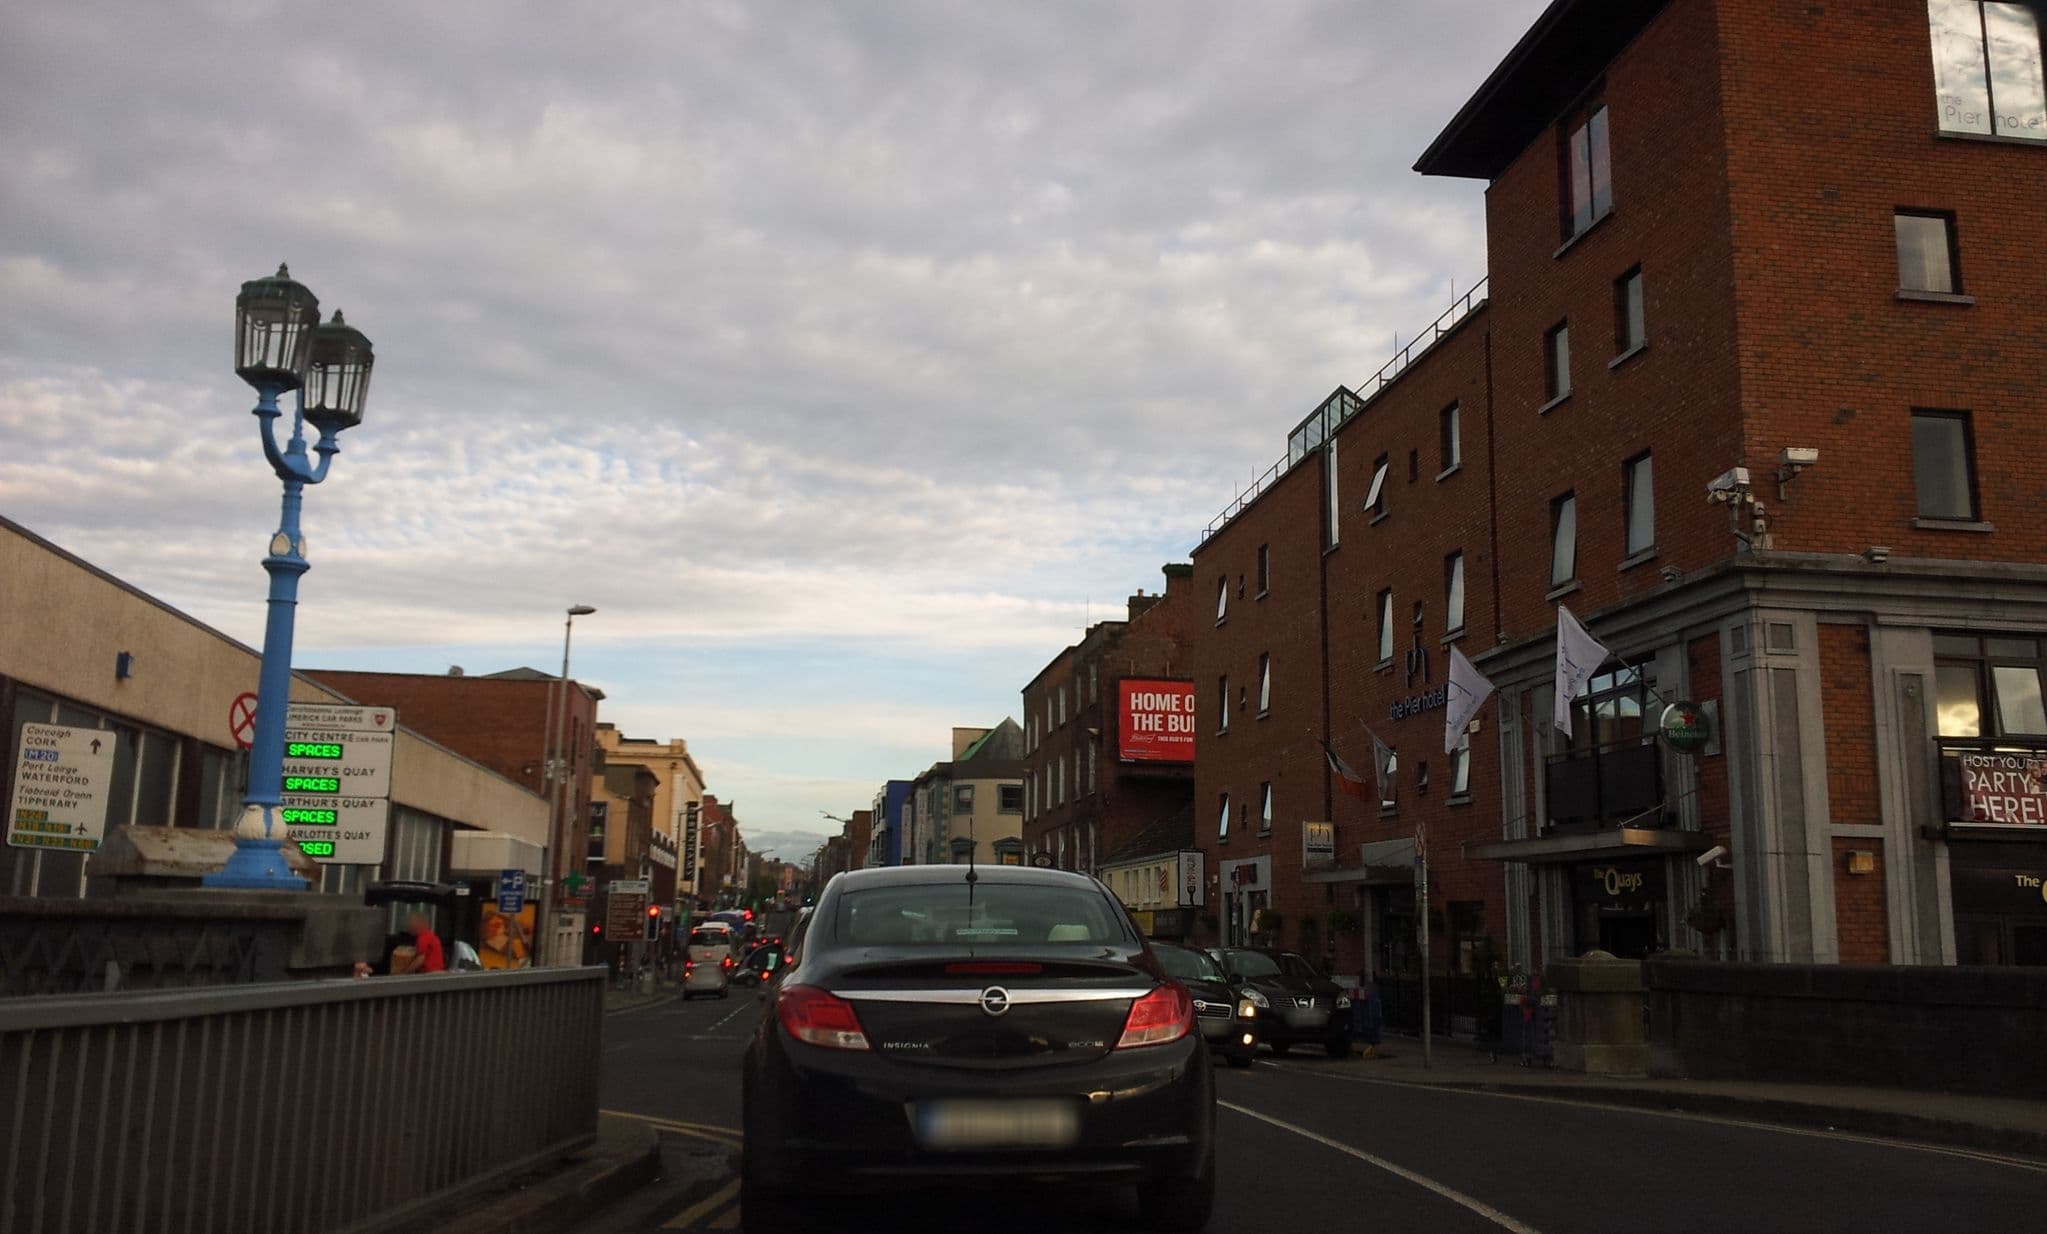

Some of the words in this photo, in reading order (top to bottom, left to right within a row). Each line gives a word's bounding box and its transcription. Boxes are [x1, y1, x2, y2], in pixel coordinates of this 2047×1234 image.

[1131, 692, 1181, 712] HOME
[1131, 713, 1164, 732] THE
[26, 737, 57, 747] CORK
[285, 731, 308, 741] CITY
[312, 732, 354, 743] CENTRE
[288, 744, 341, 757] SPACES
[1963, 755, 1996, 768] HOST
[342, 767, 376, 777] QUAY
[22, 772, 89, 786] WATERFORD
[285, 777, 338, 791] SPACES
[1968, 770, 2031, 793] PARTY
[18, 796, 78, 809] TIPPERARY
[342, 799, 375, 808] QUAY
[1970, 794, 2045, 824] HERE!
[283, 810, 335, 823] SPACES
[287, 830, 341, 840] ARLOTTE'S
[344, 831, 371, 840] QUAY
[299, 842, 333, 855] SED
[1605, 868, 1643, 896] Quays
[2015, 875, 2040, 888] The
